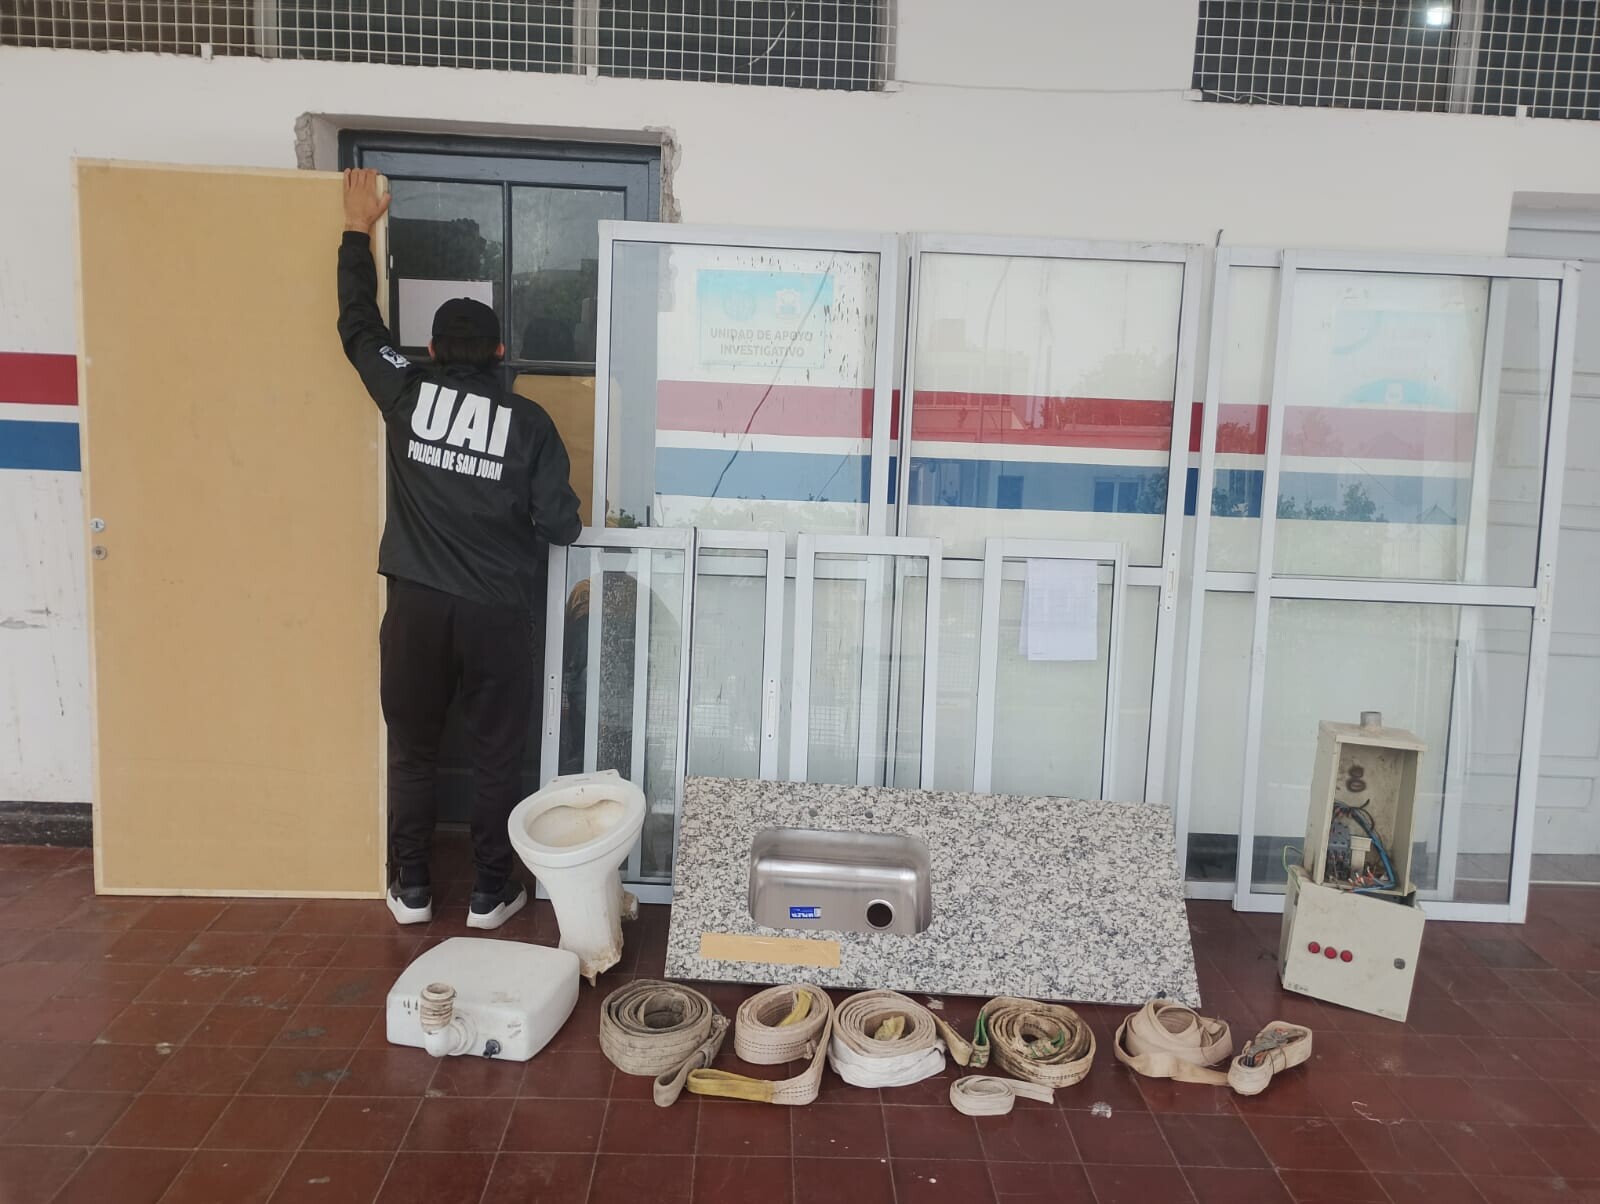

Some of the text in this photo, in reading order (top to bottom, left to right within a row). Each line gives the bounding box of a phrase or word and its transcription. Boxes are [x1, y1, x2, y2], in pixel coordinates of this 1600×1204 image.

[710, 328, 813, 342] UNIDAD DE APOYO
[720, 344, 805, 357] INVESTIGATIVO
[411, 382, 512, 457] UAI
[408, 440, 503, 480] POLICIA DE SAN JUAN
